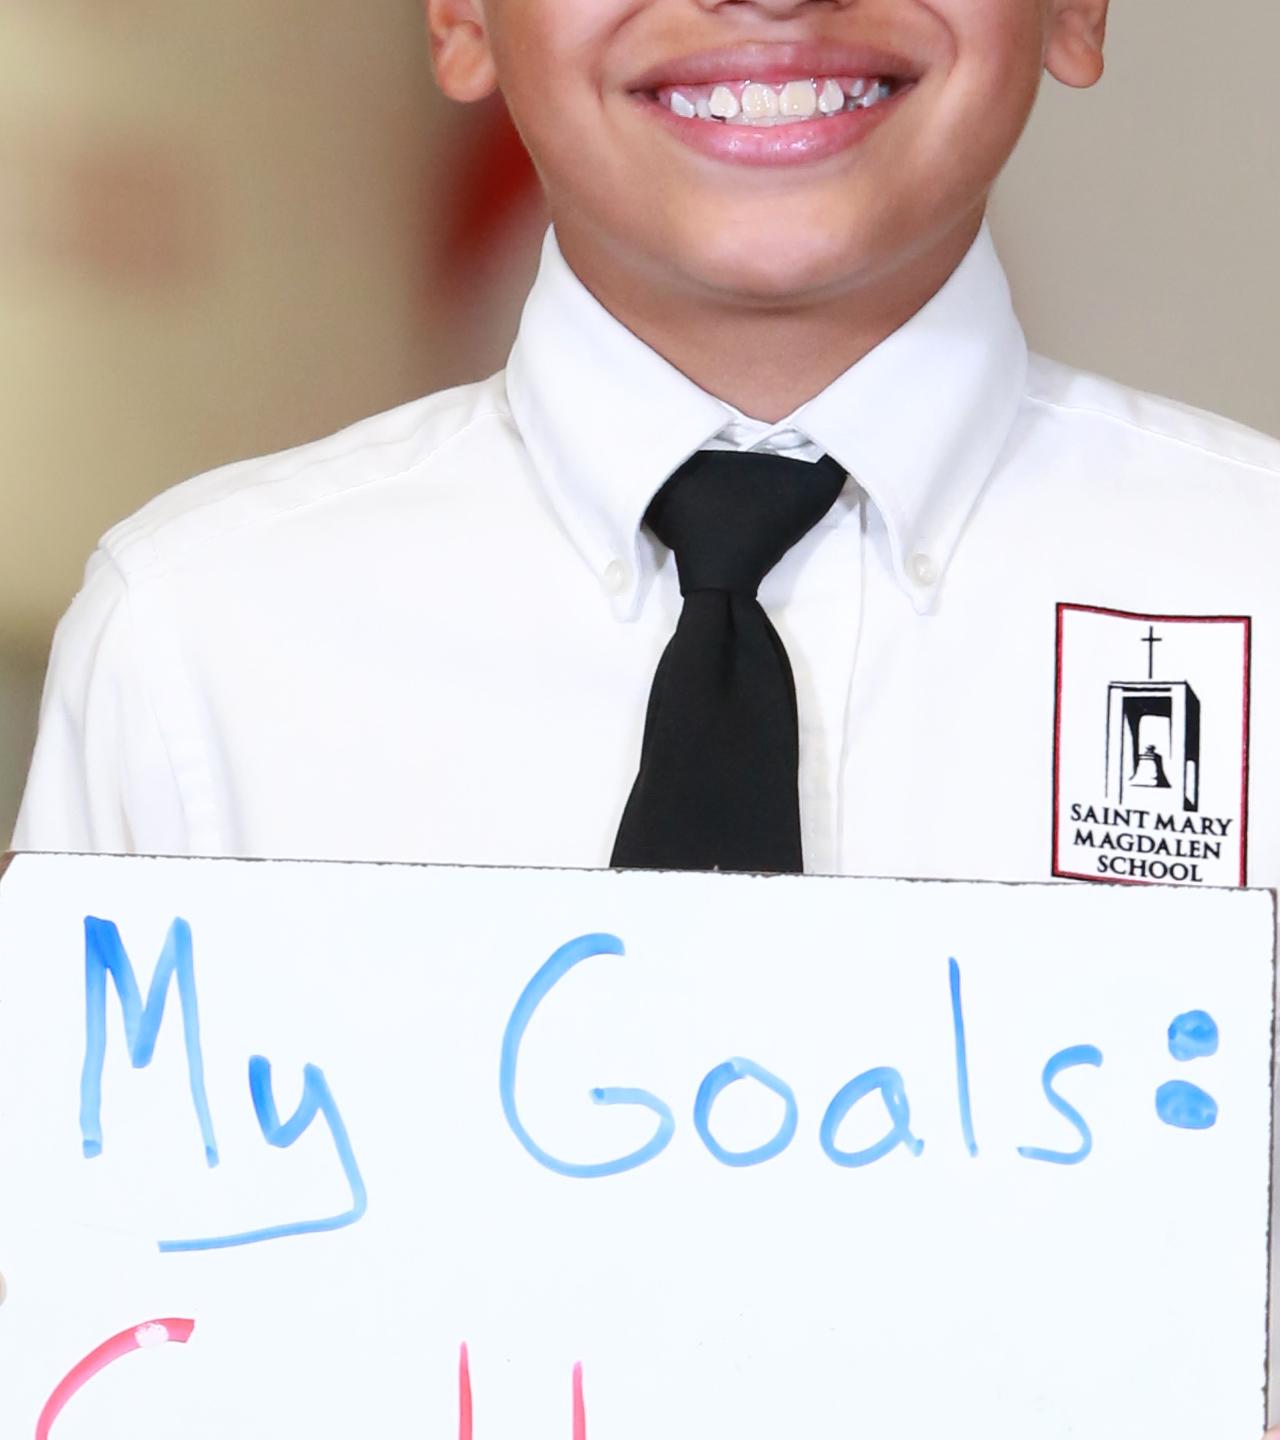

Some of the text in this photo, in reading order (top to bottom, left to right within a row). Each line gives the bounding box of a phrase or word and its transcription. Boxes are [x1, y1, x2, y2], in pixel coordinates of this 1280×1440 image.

[1070, 803, 1233, 836] SAINT MARY
[1073, 828, 1222, 859] MAGDALEN
[1097, 855, 1203, 883] SCHOOL
[80, 915, 1219, 1252] My Goals:
